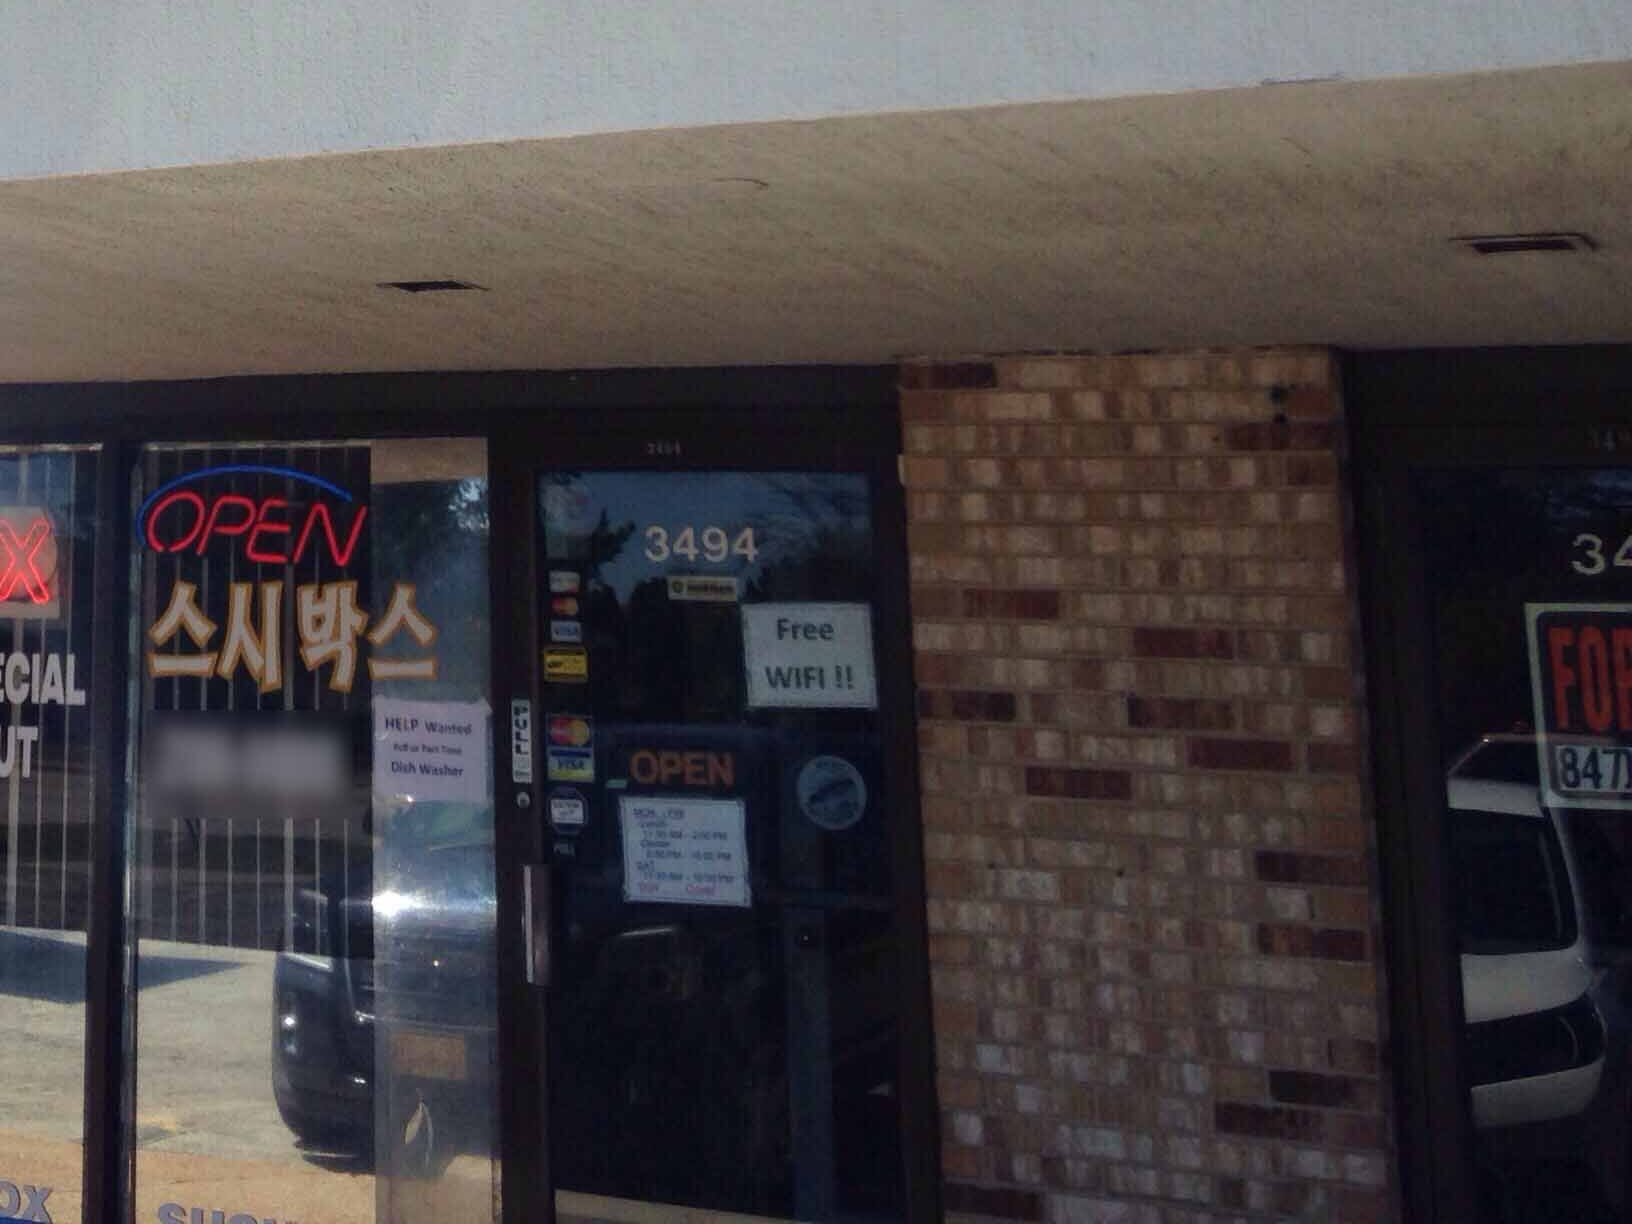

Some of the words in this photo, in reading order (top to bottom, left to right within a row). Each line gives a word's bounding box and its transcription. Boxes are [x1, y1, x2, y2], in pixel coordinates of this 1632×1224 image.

[147, 490, 367, 566] OPEN
[645, 525, 759, 562] 3494
[148, 580, 438, 694] 스시박스
[776, 617, 834, 640] Free
[385, 717, 419, 732] HELP
[425, 722, 472, 735] Wanted
[391, 762, 416, 774] Dish
[419, 764, 464, 777] Washer
[630, 750, 735, 788] OPEN
